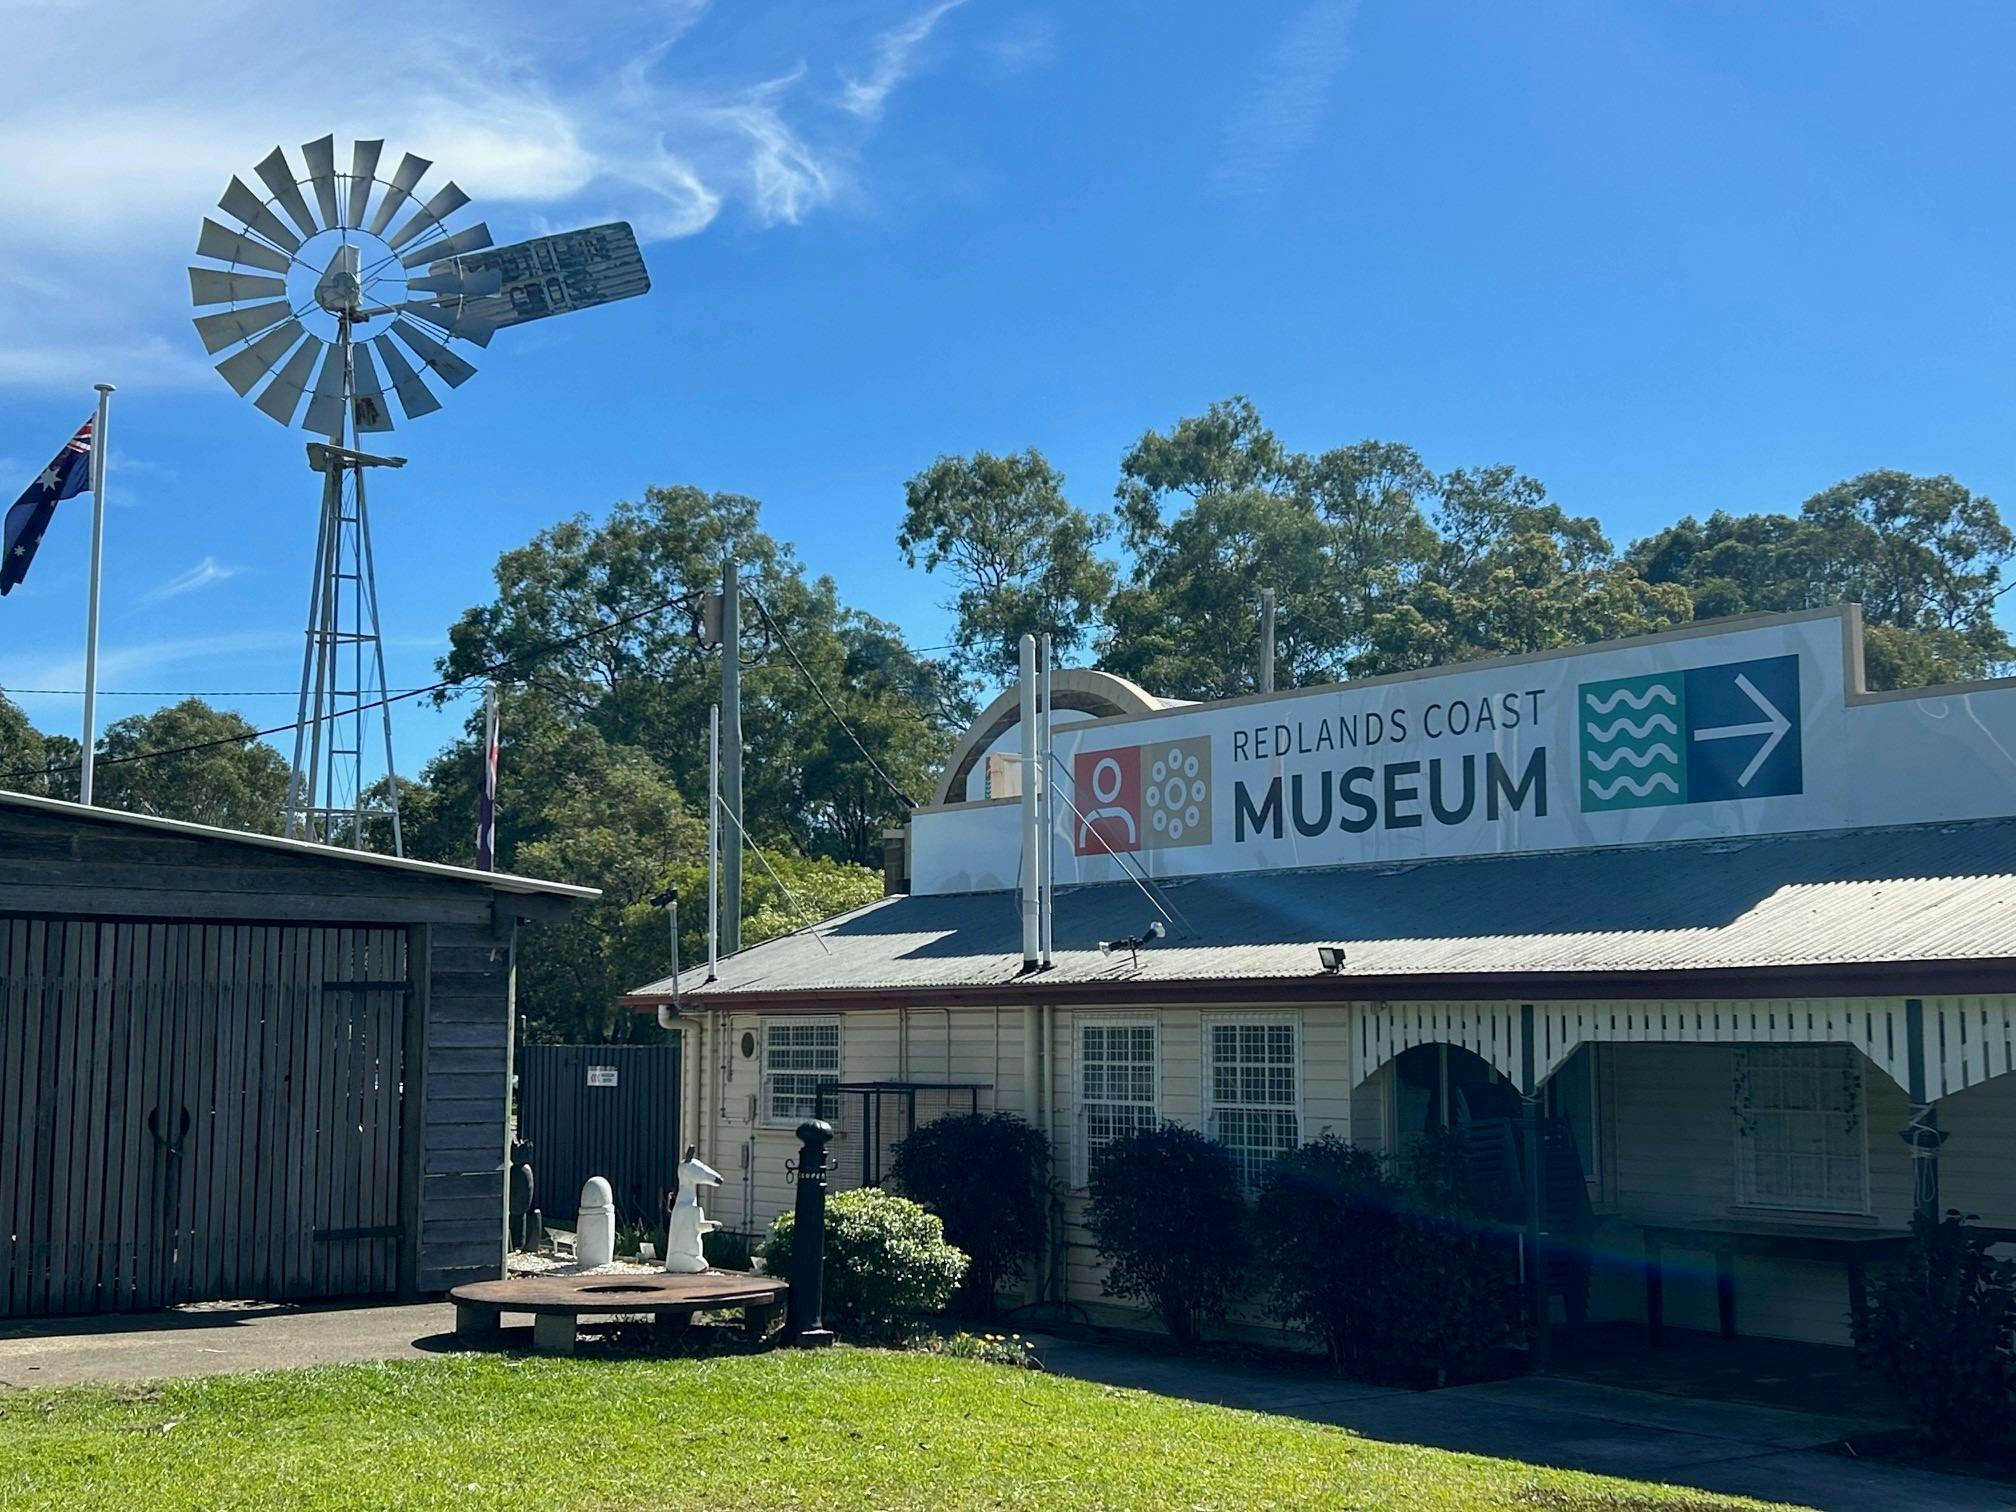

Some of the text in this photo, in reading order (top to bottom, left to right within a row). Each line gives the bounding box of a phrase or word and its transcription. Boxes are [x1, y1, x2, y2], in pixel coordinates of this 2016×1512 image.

[1234, 689, 1546, 762] REDLANDS COAST
[1234, 746, 1547, 843] MUSEUM
